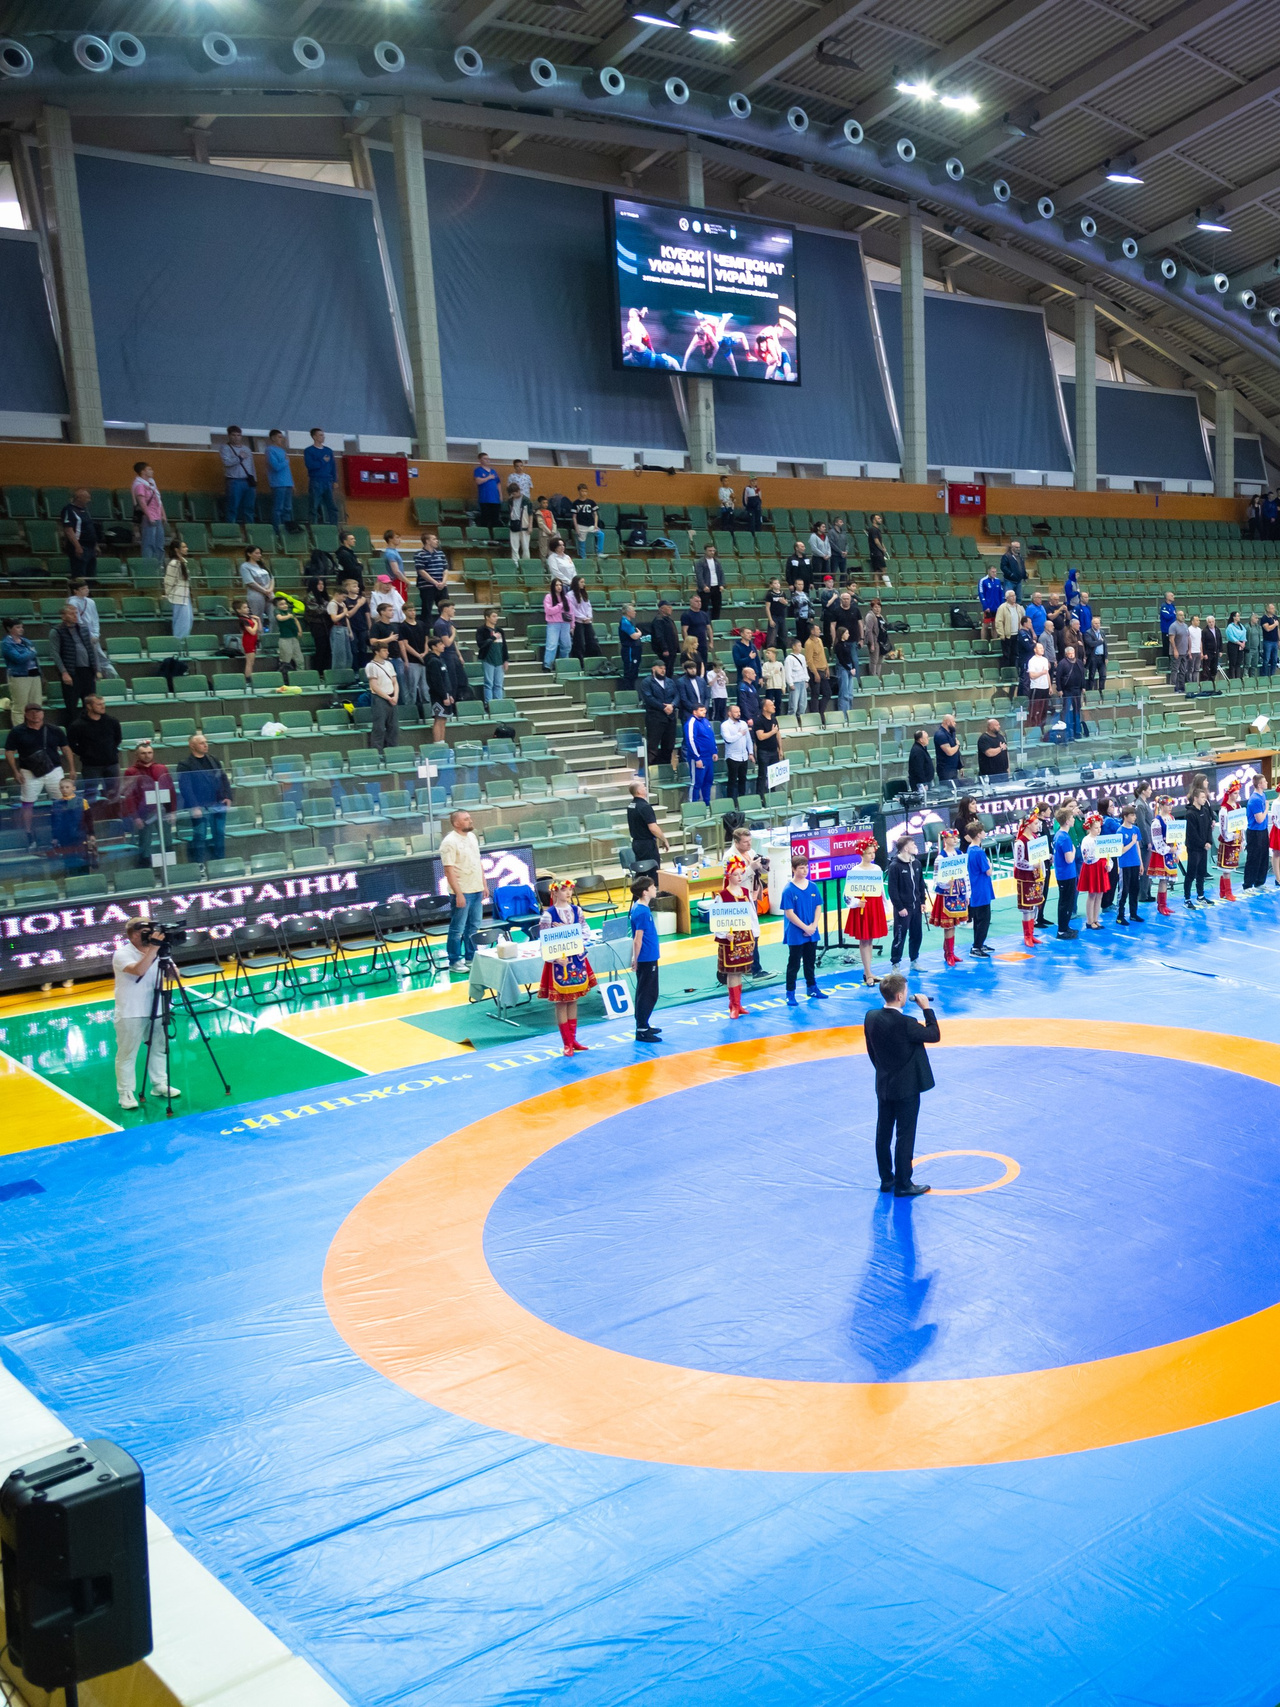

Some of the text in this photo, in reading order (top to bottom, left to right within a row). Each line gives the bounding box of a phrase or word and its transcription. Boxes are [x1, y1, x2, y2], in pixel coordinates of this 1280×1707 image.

[660, 245, 705, 263] КУБОК
[648, 258, 705, 279] УКРАЇНИ
[713, 253, 785, 276] ЧЕМПІОНАТ
[714, 267, 768, 288] УКРАЇНИ
[977, 786, 1100, 815] ЧЕМПІОНАТ
[1099, 846, 1119, 854] ОБЛАСТЬ
[940, 857, 966, 869] ДОНЕЦЬКА
[941, 868, 963, 878] ОБЛАСТЬ
[850, 884, 877, 892] ОБЛАСТЬ
[712, 907, 749, 916] ВОЛИНСЬКА
[716, 918, 746, 928] ОБЛАСТЬ
[543, 928, 580, 943] ВІННИЦЬКА
[548, 941, 579, 954] ОБЛАСТЬ
[10, 949, 66, 969] та
[606, 983, 630, 1014] C
